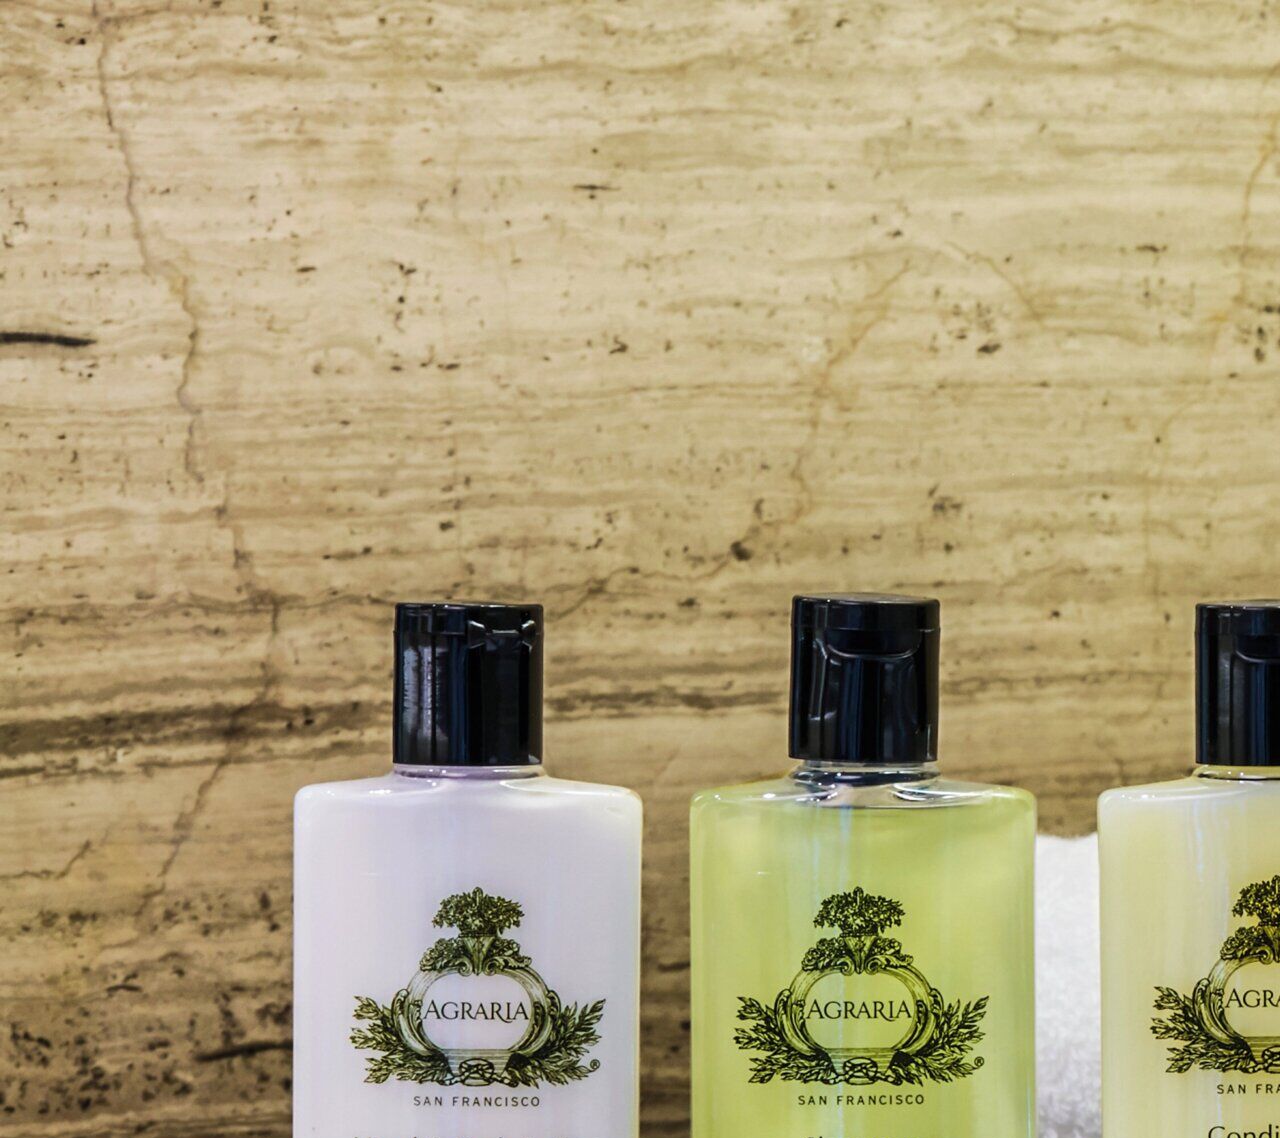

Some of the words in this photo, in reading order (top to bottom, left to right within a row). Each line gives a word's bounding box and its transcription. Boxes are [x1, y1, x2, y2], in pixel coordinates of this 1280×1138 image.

[424, 999, 529, 1023] AGRARIA
[806, 998, 912, 1023] AGRARIA
[1216, 1083, 1246, 1094] SAN
[413, 1095, 443, 1107] SAN
[452, 1095, 540, 1107] FRANCISCO
[798, 1095, 828, 1106] SAN
[836, 1094, 925, 1105] FRANCISCO
